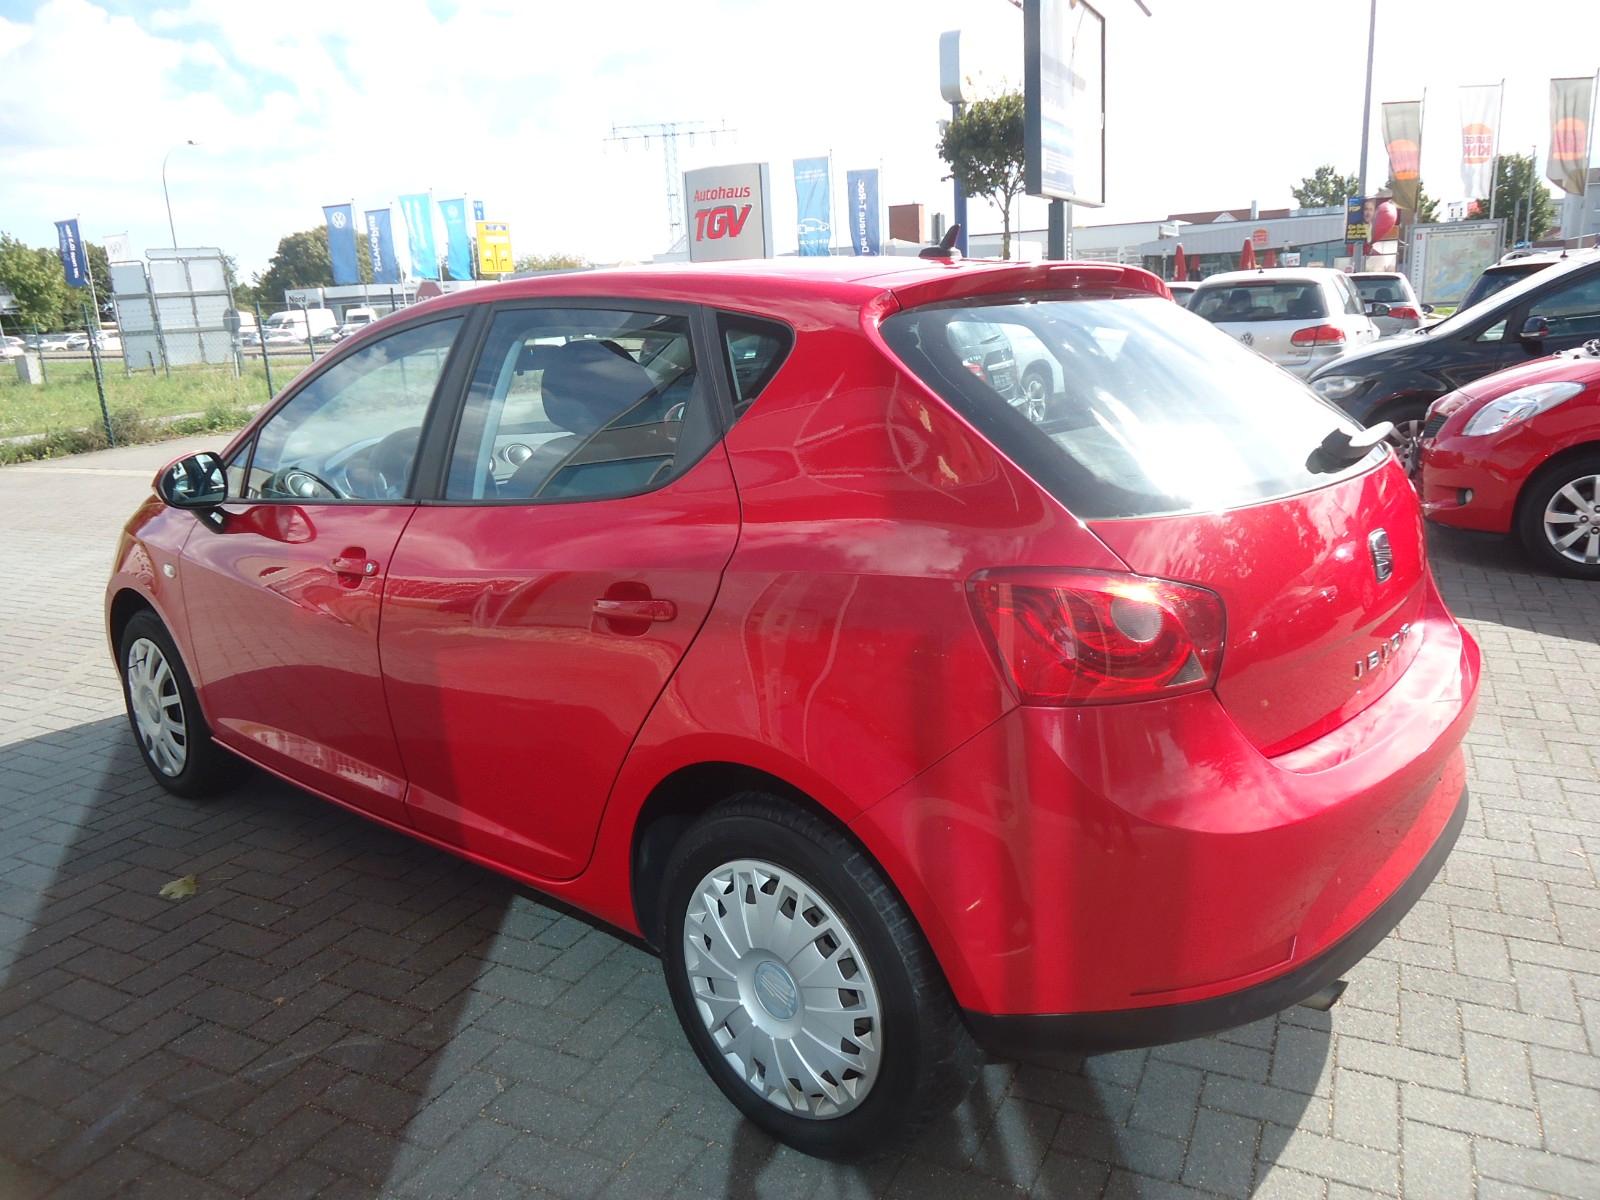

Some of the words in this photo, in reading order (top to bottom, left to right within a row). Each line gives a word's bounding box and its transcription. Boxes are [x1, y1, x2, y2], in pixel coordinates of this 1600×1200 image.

[694, 186, 751, 202] Autohaus
[695, 204, 753, 242] TGV
[288, 295, 306, 304] Nord
